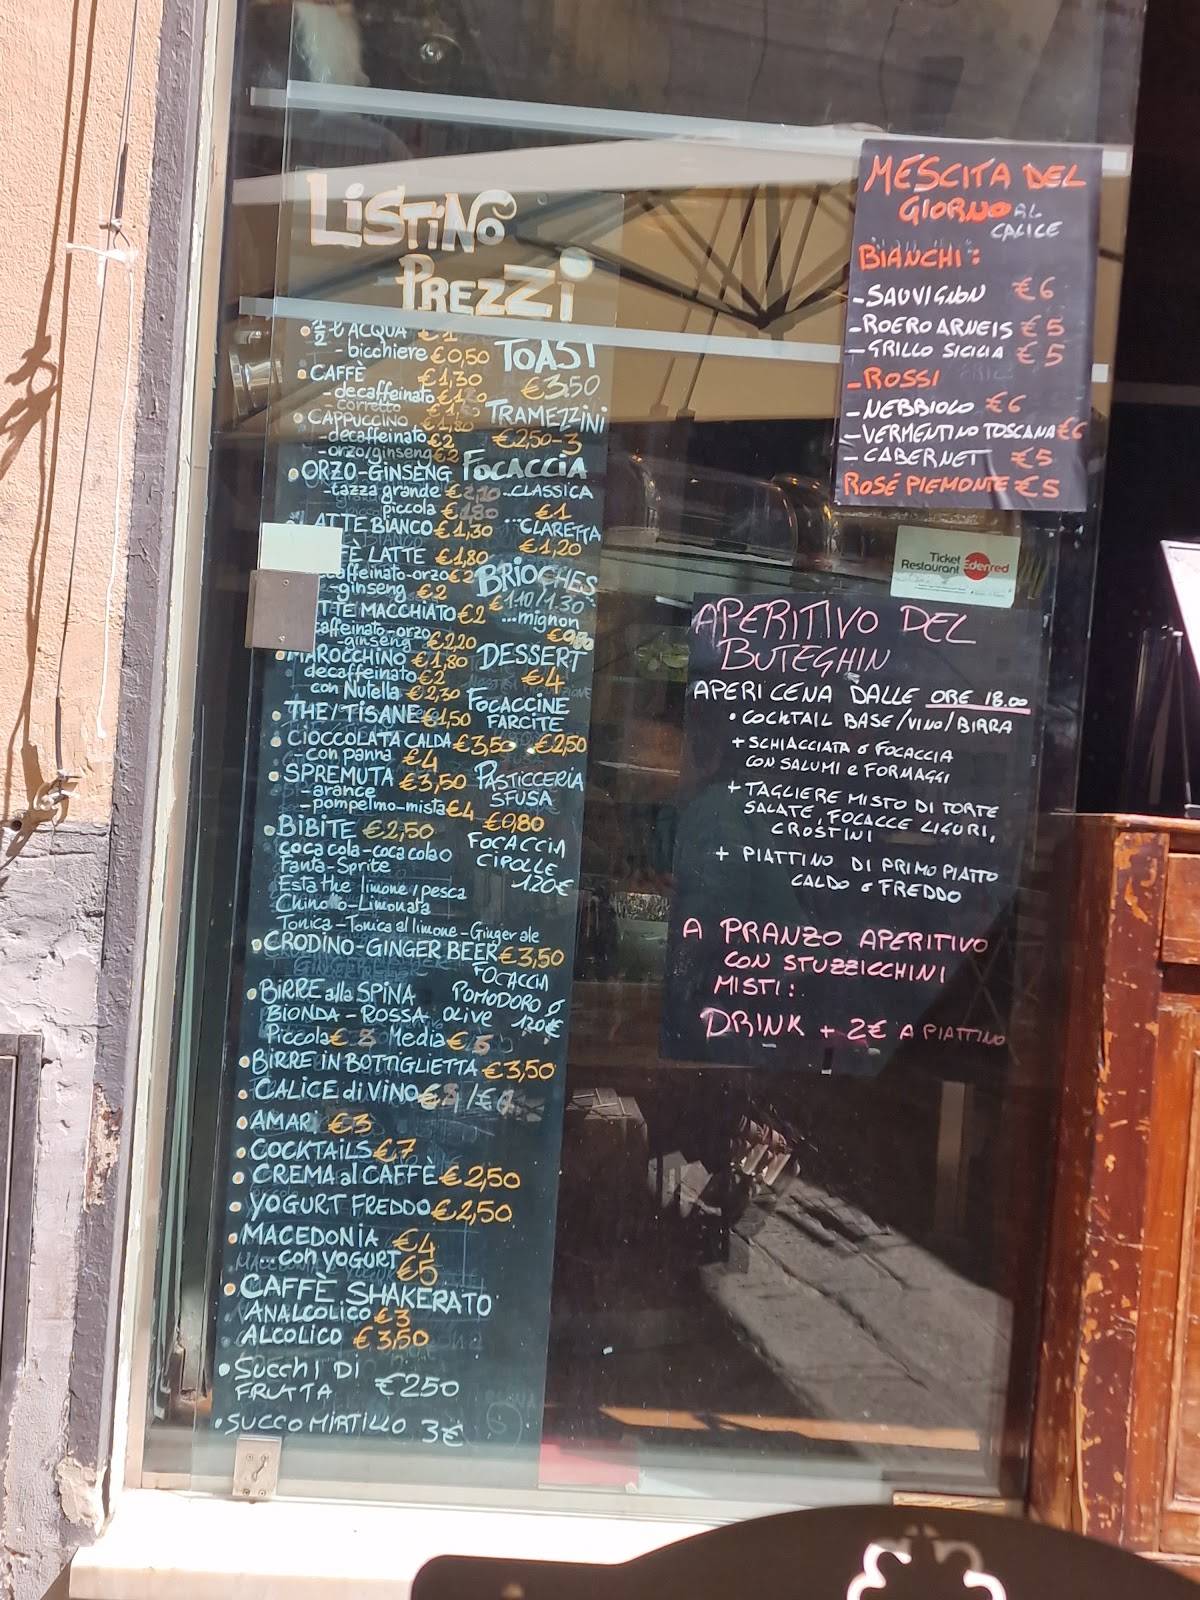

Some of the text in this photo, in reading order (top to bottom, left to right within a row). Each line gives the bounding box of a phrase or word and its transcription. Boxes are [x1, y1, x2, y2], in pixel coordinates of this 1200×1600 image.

[864, 154, 1087, 196] MESCITA DEL
[899, 196, 1013, 227] GIORNO
[990, 221, 1063, 241] CALICE
[936, 317, 1013, 339] ARNEIS
[431, 346, 490, 370] €0,50
[310, 361, 366, 382] CAFFÈ
[308, 409, 408, 427] CAPPUCCINO
[983, 422, 1057, 440] TOSCANA
[381, 484, 441, 505] grande
[906, 475, 1010, 496] PIEMONTE
[382, 499, 437, 520] piccola
[369, 545, 426, 565] LATTE
[929, 552, 961, 565] Ticket
[901, 559, 961, 575] Restaurant
[690, 598, 976, 645] APERITIVO DEL
[476, 643, 588, 672] DESSERT
[717, 637, 890, 679] BUTEGHIN
[304, 664, 417, 682] decaffeinato
[310, 682, 339, 695] con
[344, 680, 400, 700] Nutella
[850, 683, 920, 705] DALLE
[930, 689, 974, 705] ORE
[404, 732, 451, 749] CALDA
[748, 736, 954, 764] SCHIACCIATA FOCACCIA
[343, 748, 391, 766] panna
[283, 763, 394, 787] SPREMUTA
[745, 755, 950, 785] CON SALUMI FORMAGGI
[489, 789, 553, 808] SFUSA
[745, 781, 999, 819] TAGLIERE MISTO DI TORTE
[826, 810, 913, 830] FOCACCE
[771, 822, 872, 843] CROSTINI
[743, 846, 999, 883] PIATTINO DI PRIMO PIATTO
[791, 873, 962, 903] CALDO FREDDO
[683, 918, 989, 953] A PRANZO APERITIVO
[447, 941, 498, 962] BEER
[725, 952, 946, 983] CON STUZZICCHINI
[325, 980, 354, 1003] alla
[452, 980, 541, 1013] POMODORO
[361, 1004, 430, 1024] ROSSA
[266, 1023, 445, 1047] Piccola Media
[700, 1007, 805, 1039] DRINK
[899, 1024, 914, 1041] A
[923, 1025, 1006, 1046] PIATTINO
[252, 1163, 335, 1185] CREMA
[362, 1156, 438, 1185] CAFFÈ
[250, 1193, 347, 1221] YOGURT
[352, 1199, 431, 1216] FREDDO
[240, 1273, 492, 1316] CAFFÈ SHAKERATO
[235, 1381, 332, 1401] FRUTTA
[225, 1413, 302, 1435] SUCCO
